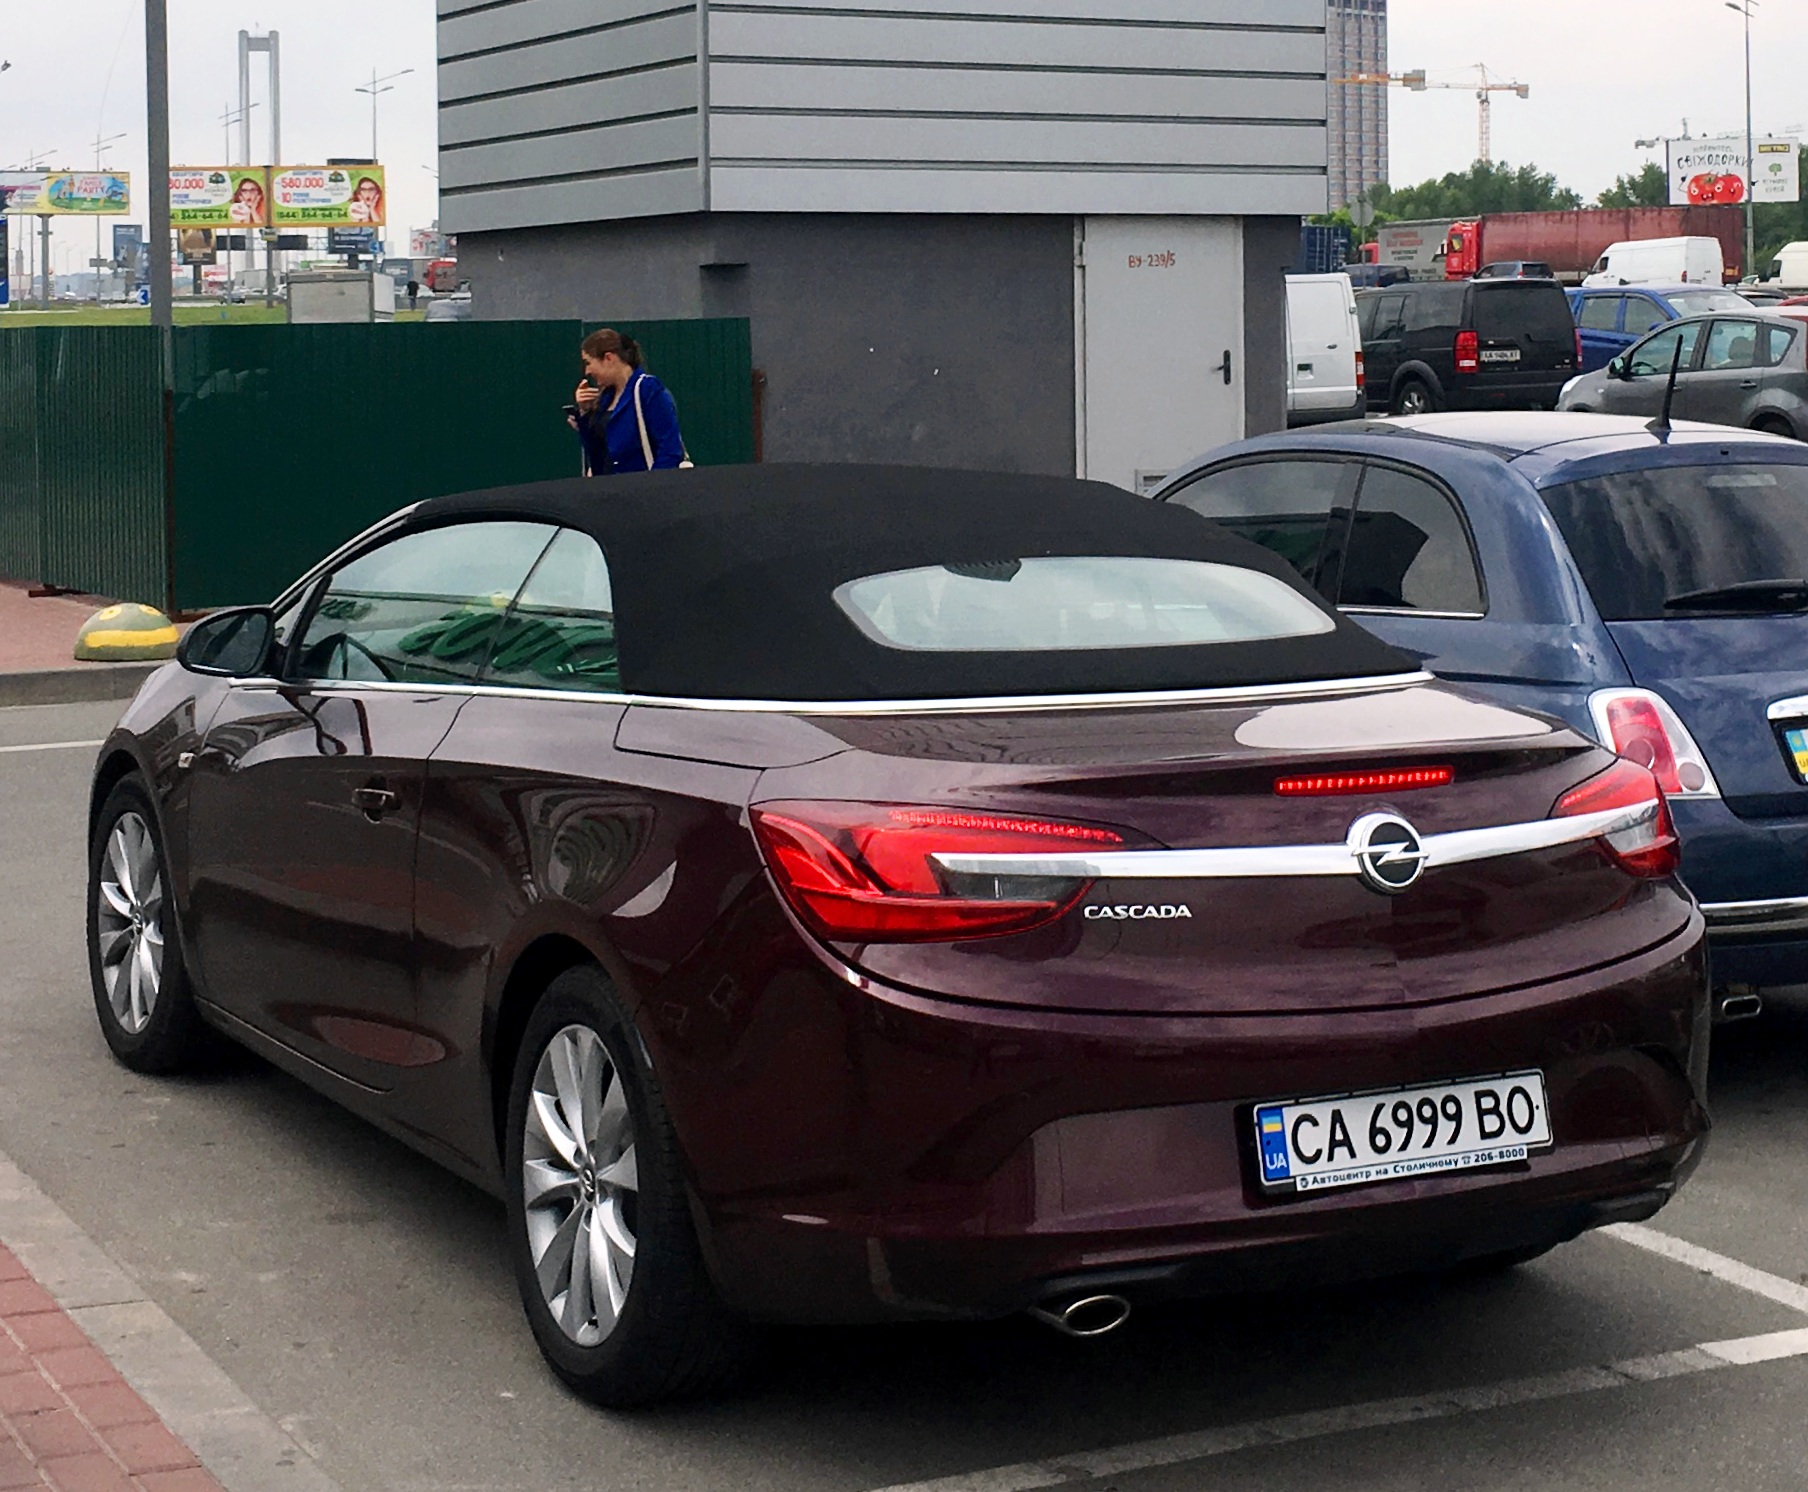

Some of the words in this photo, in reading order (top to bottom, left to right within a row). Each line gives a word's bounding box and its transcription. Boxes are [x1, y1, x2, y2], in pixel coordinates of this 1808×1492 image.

[1083, 904, 1192, 919] CASCADA
[1291, 1108, 1357, 1165] CA
[1369, 1094, 1462, 1154] 6999
[1474, 1085, 1535, 1141] BO
[1265, 1152, 1288, 1170] UA
[1311, 1169, 1372, 1186] Автоцентр
[1375, 1167, 1389, 1176] на
[1393, 1157, 1459, 1174] Столичному
[1474, 1147, 1525, 1163] 206-8000
